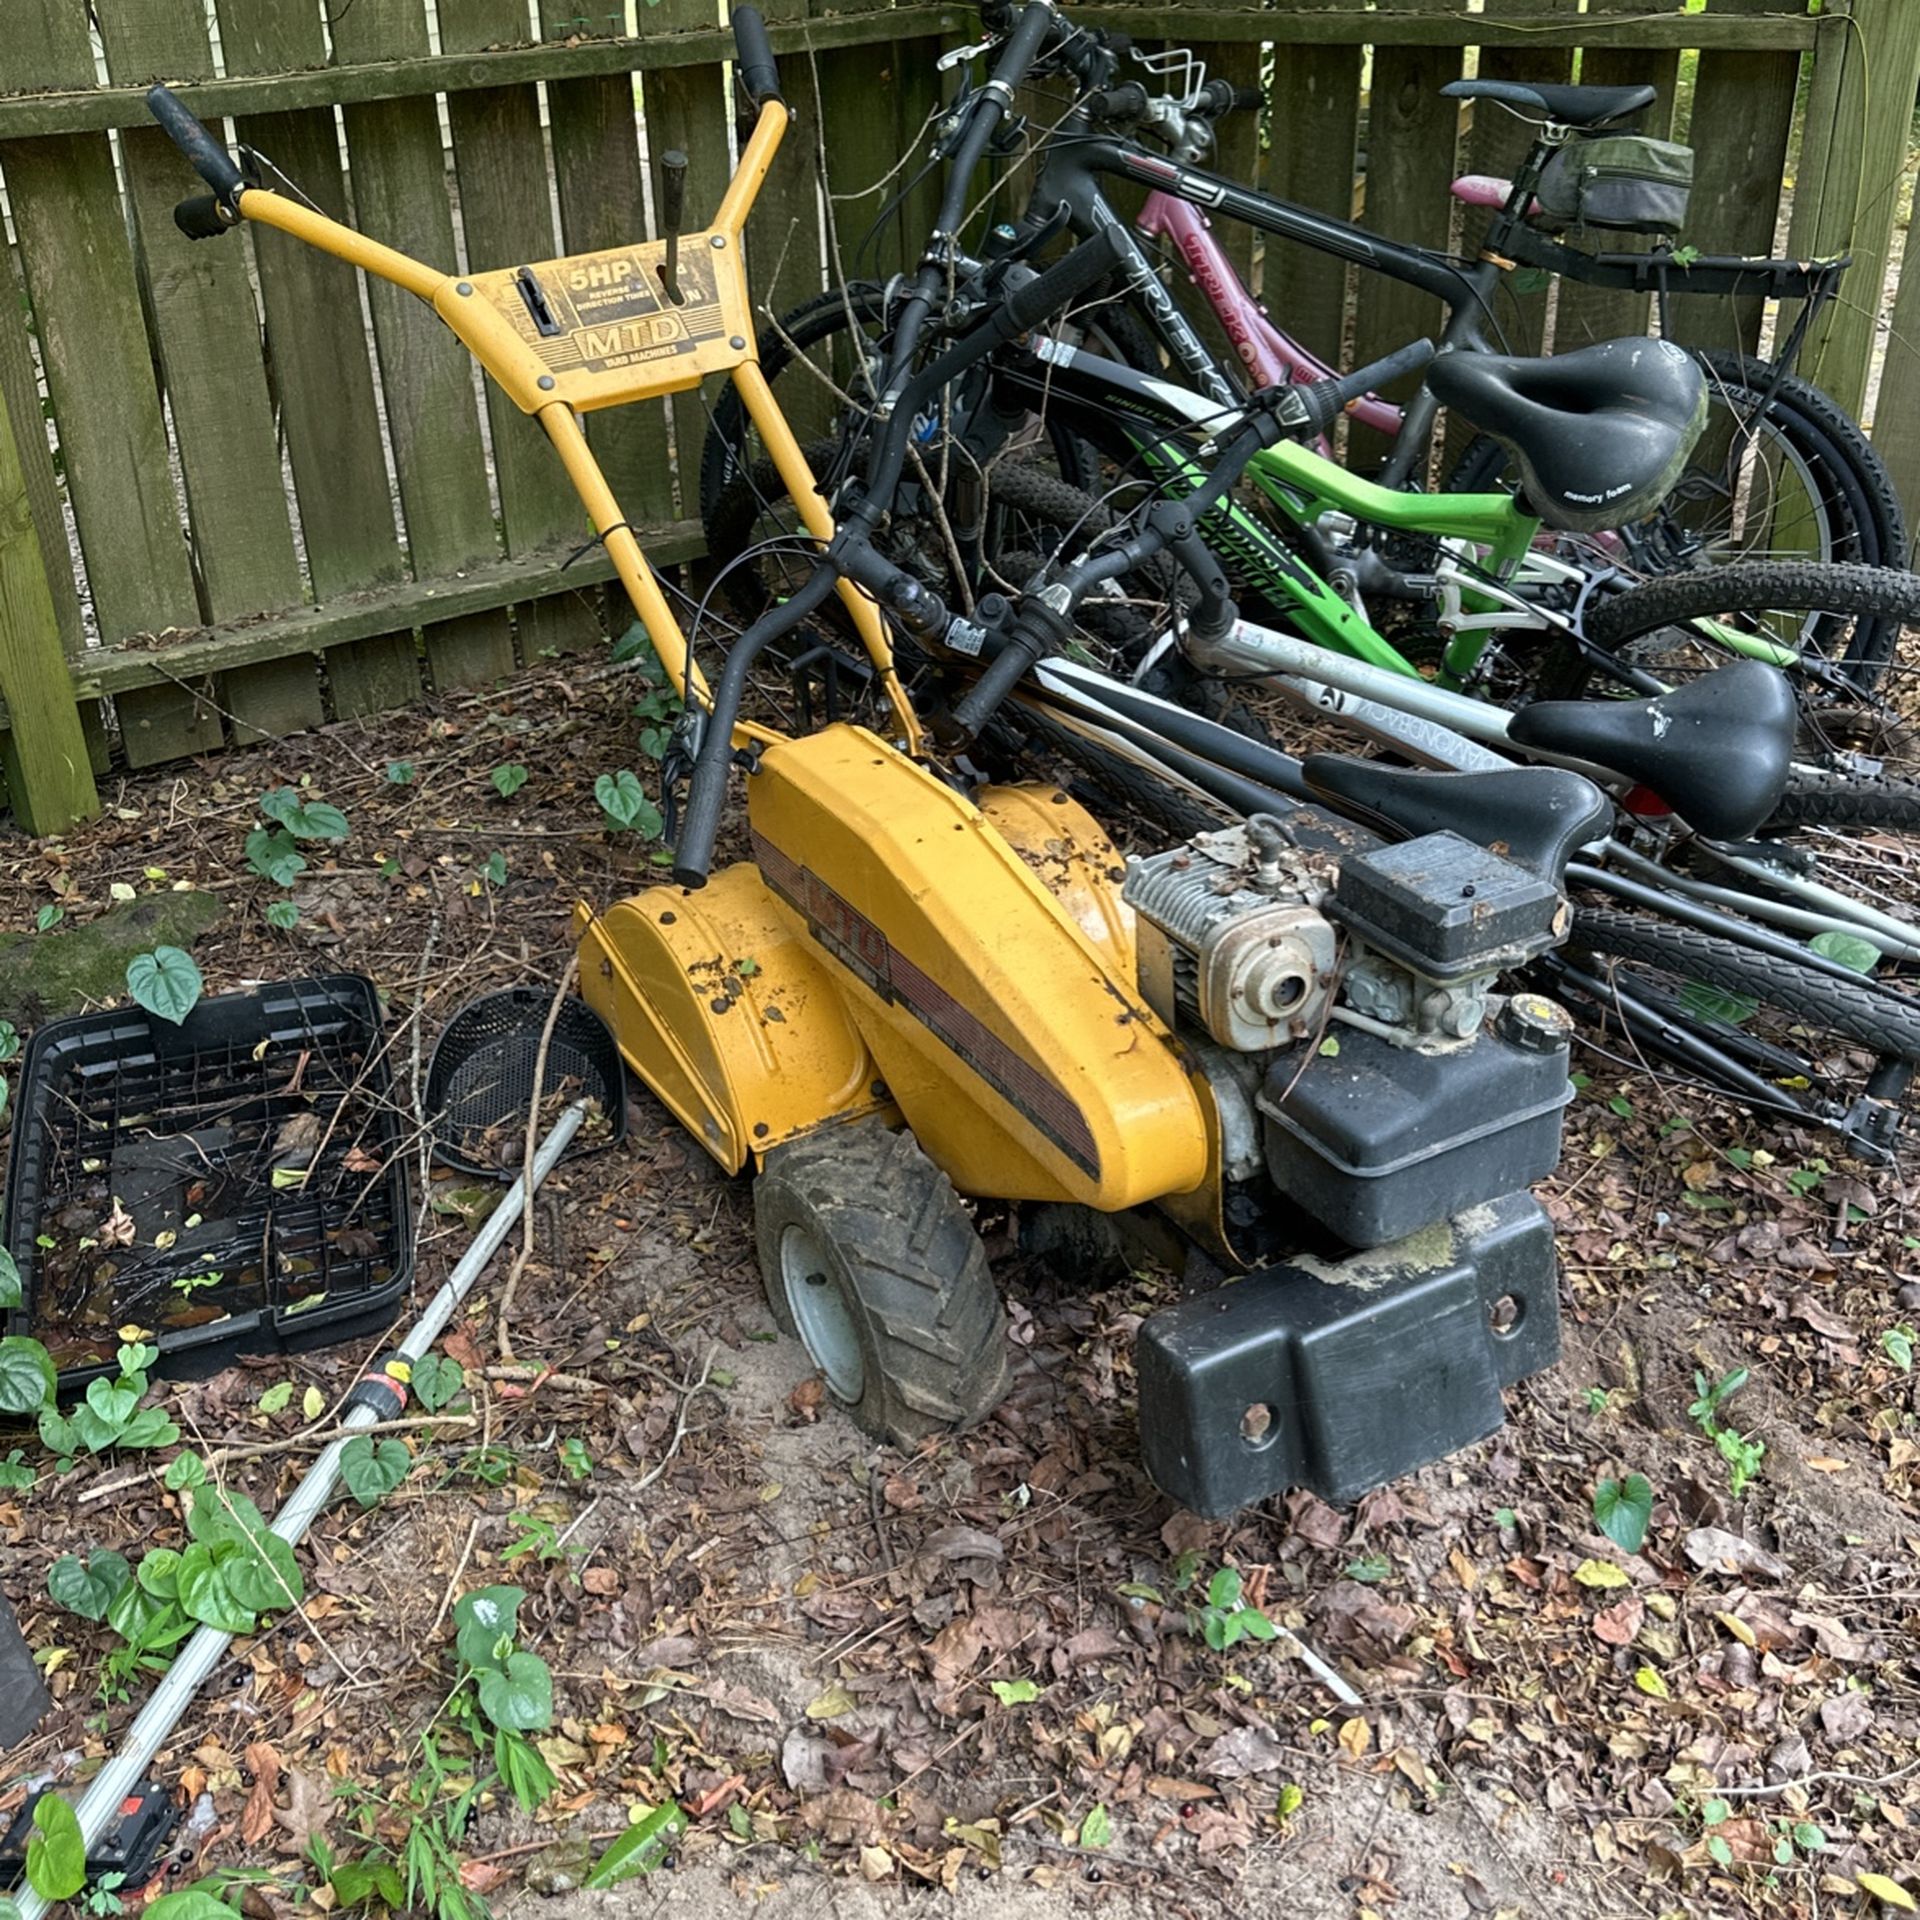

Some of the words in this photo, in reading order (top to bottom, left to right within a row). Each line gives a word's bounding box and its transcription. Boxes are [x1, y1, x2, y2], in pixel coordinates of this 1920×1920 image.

[570, 260, 631, 291] 5HP
[589, 285, 629, 299] REVERSE
[585, 316, 679, 357] MTD
[629, 345, 678, 363] MACHINES
[1563, 491, 1604, 504] memory
[1606, 483, 1632, 499] foam
